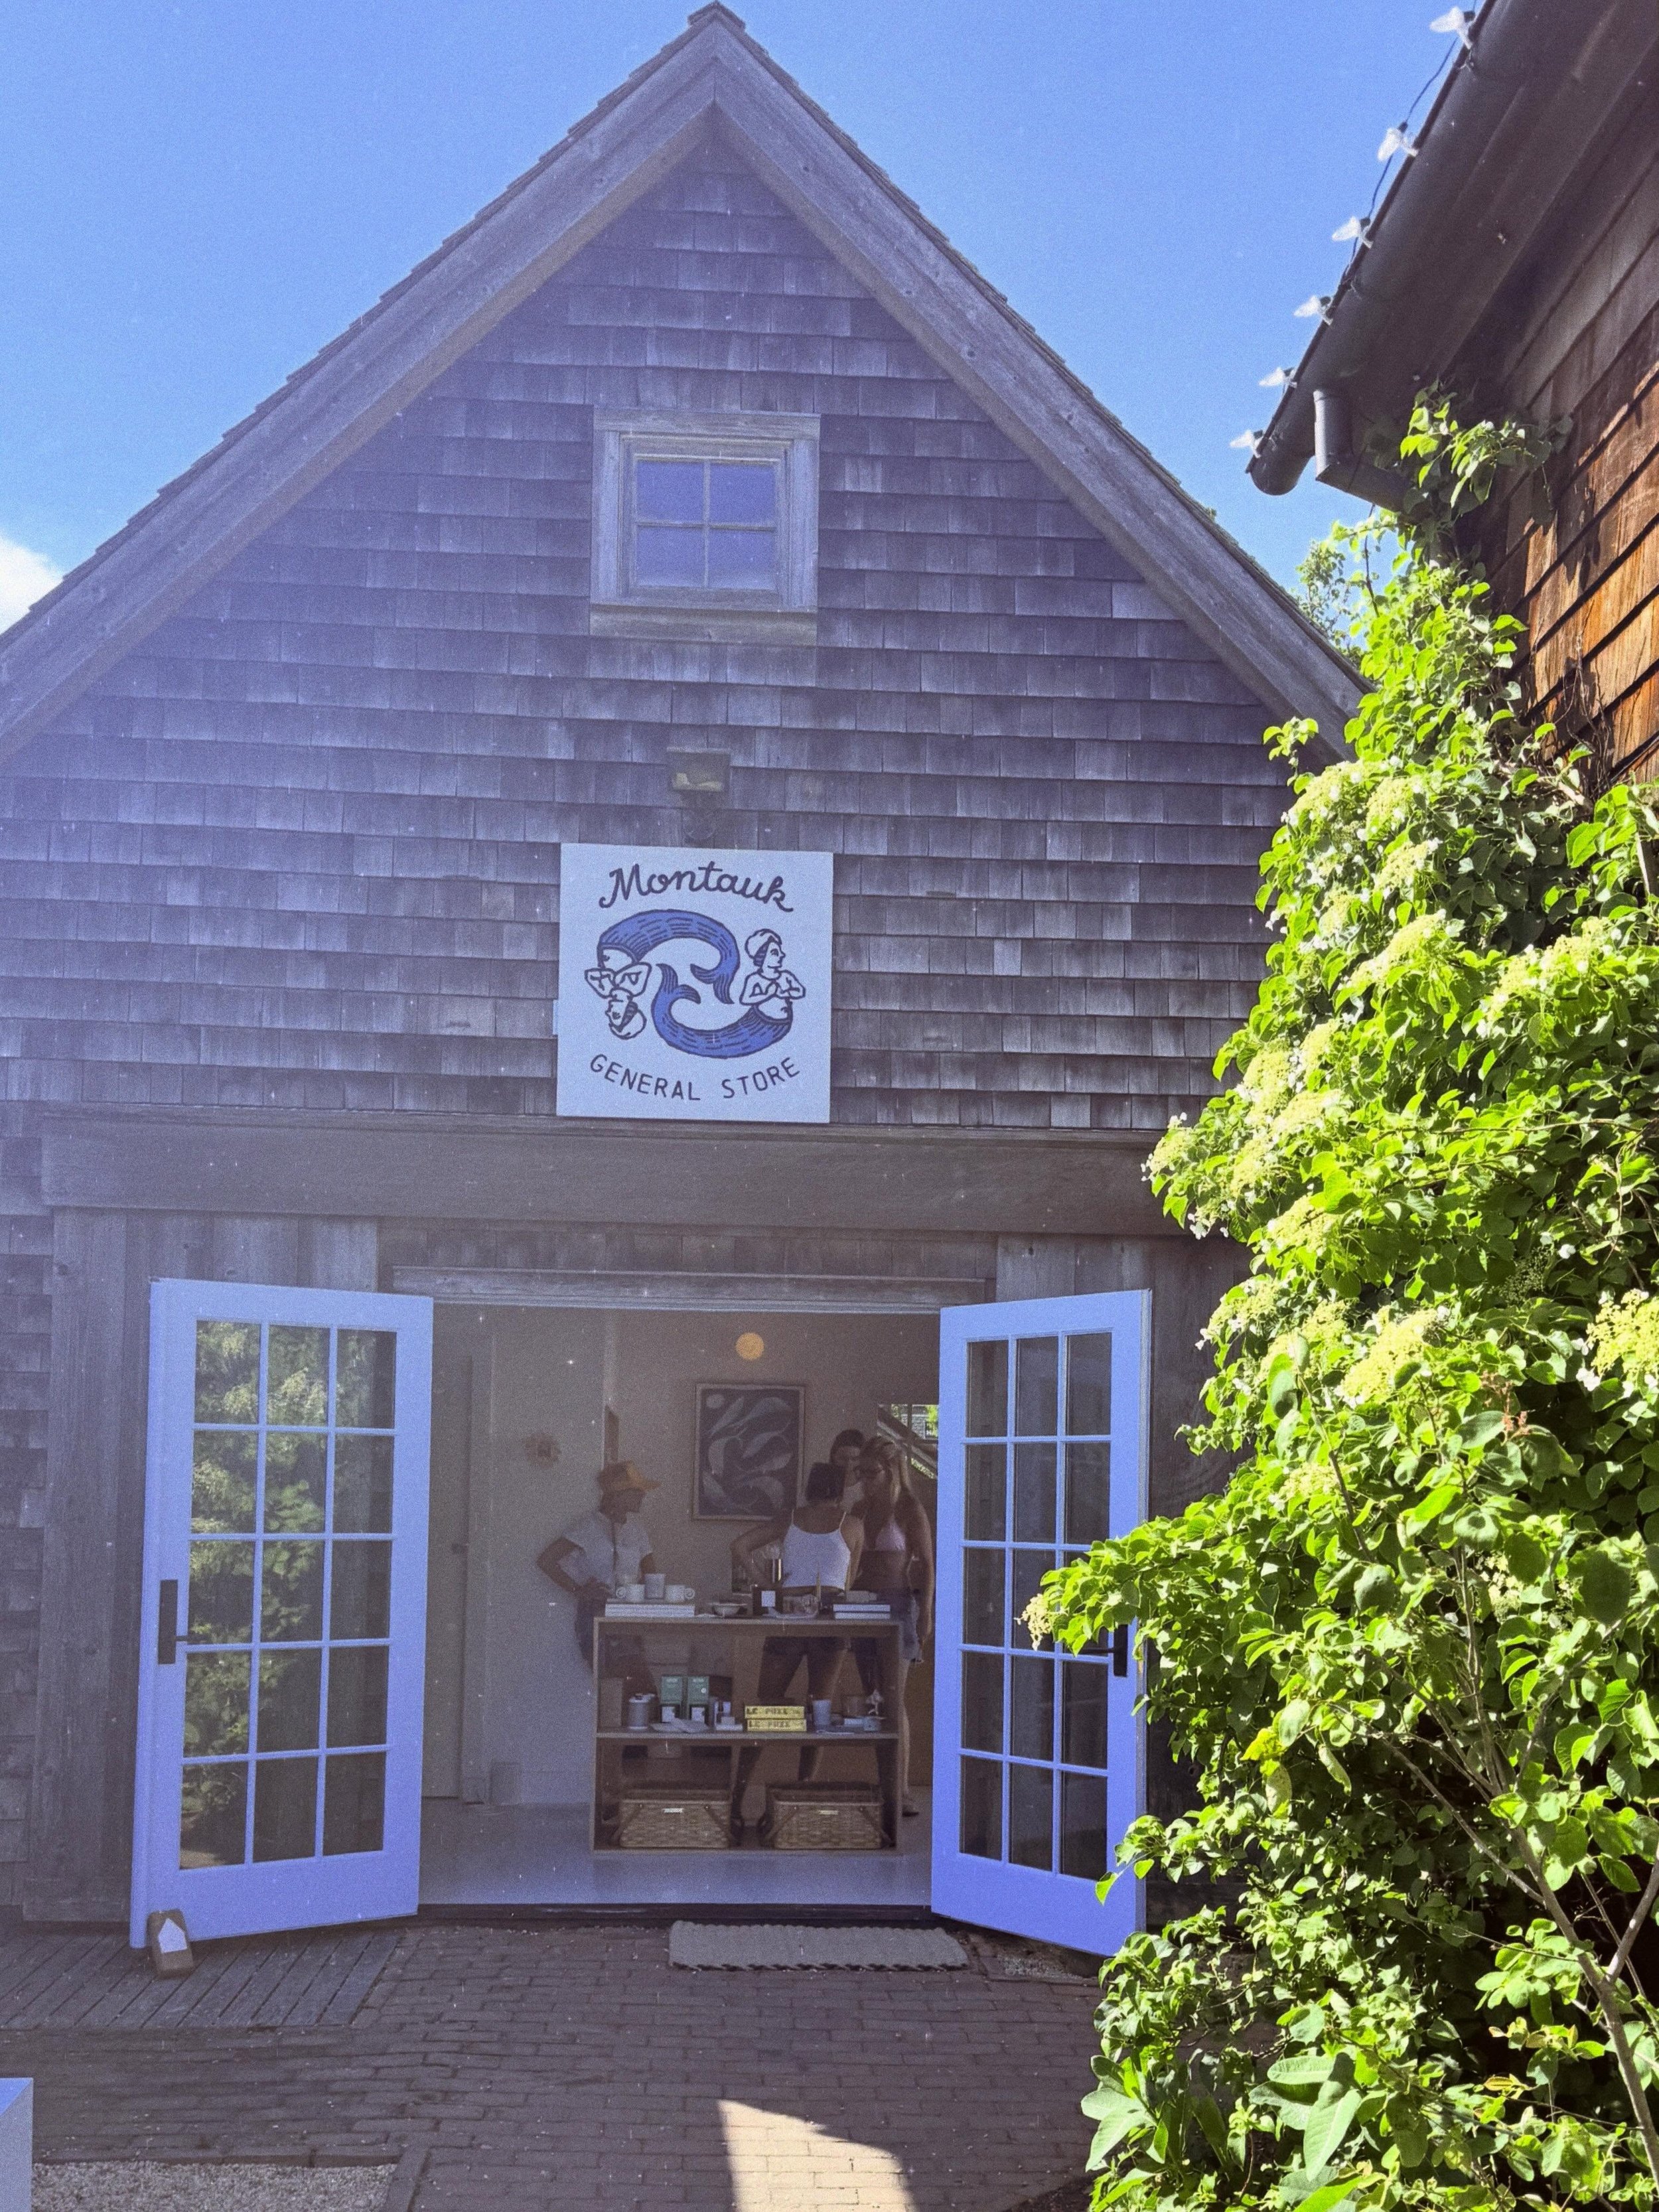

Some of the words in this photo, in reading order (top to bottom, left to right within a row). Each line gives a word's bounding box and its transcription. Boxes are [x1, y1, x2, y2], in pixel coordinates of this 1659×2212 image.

[599, 861, 794, 913] Montauk
[590, 1054, 701, 1101] GENERAL
[721, 1057, 800, 1098] STORE
